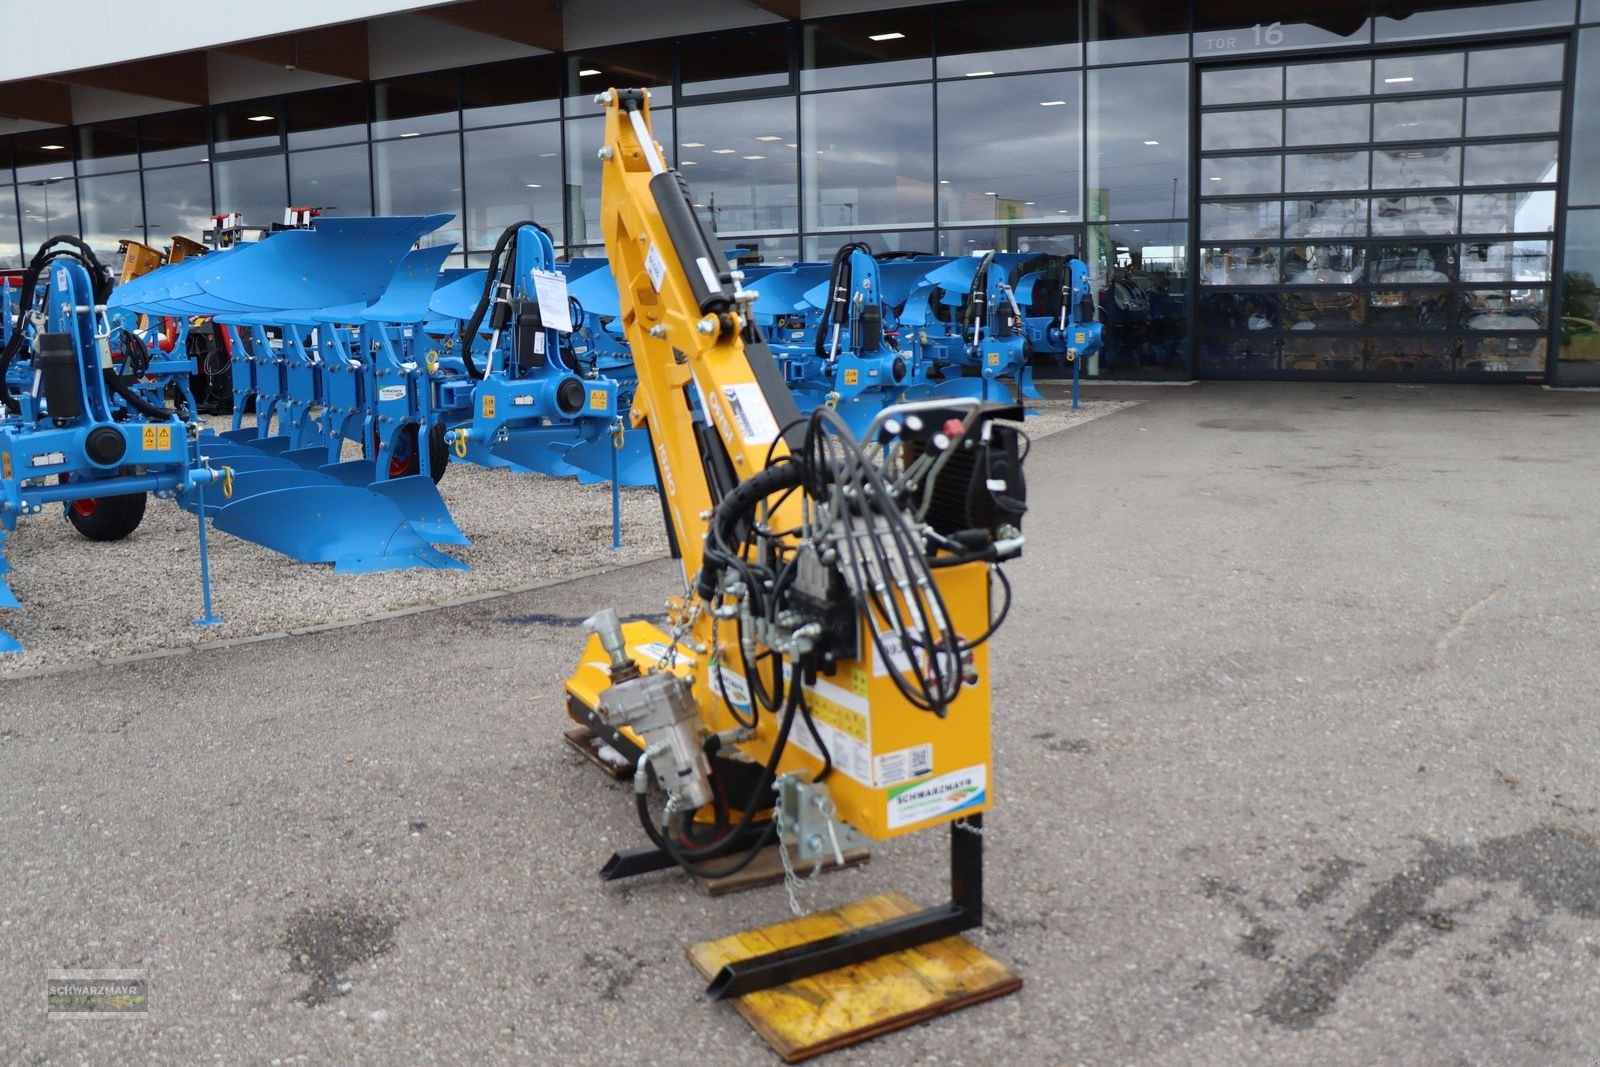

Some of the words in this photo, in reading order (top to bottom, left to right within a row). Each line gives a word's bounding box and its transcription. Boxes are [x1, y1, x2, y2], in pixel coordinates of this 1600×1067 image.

[1206, 37, 1237, 49] TOR
[1251, 21, 1284, 46] 16
[896, 778, 972, 804] SCHWARZMAYR
